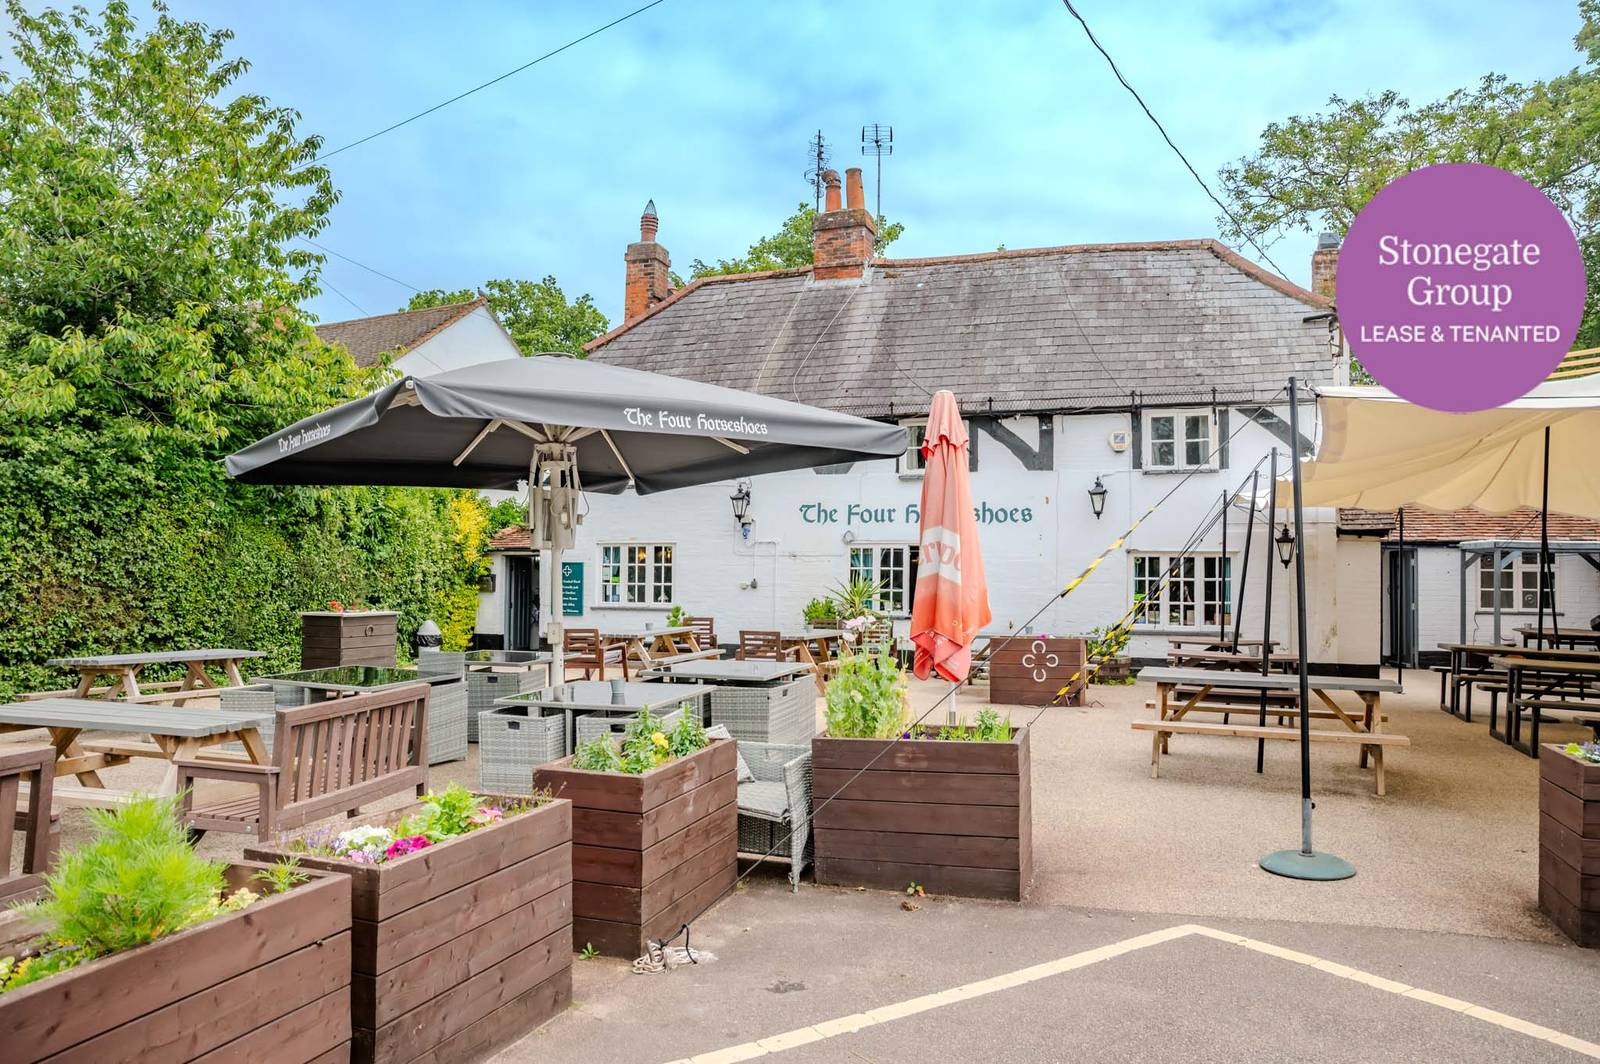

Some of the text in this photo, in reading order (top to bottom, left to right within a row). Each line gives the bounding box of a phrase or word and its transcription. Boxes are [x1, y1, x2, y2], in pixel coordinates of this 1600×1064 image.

[623, 407, 768, 435] The Four Horseshoes
[799, 502, 838, 525] The
[847, 503, 897, 526] Four
